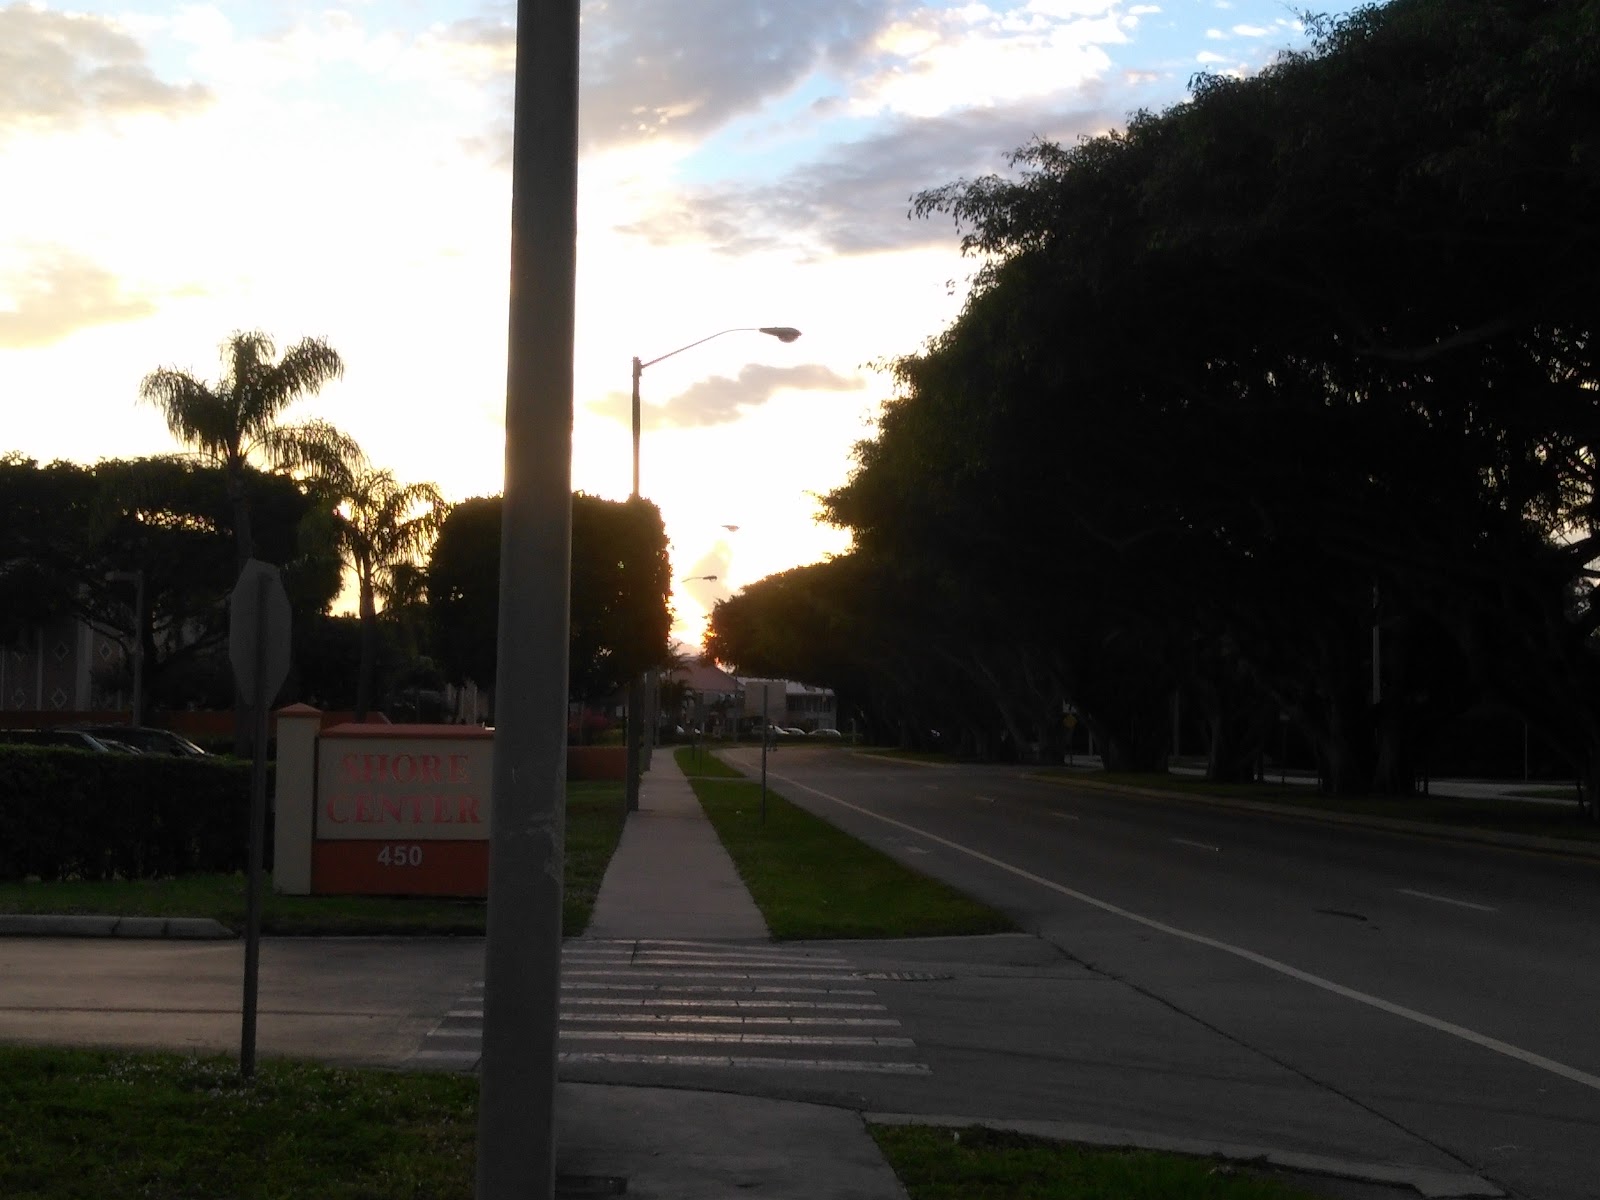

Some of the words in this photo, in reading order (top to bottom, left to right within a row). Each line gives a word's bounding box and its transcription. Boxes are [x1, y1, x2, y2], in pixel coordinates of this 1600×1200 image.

[341, 754, 470, 784] SHORE
[326, 794, 481, 824] CENTER
[377, 845, 423, 867] 450
